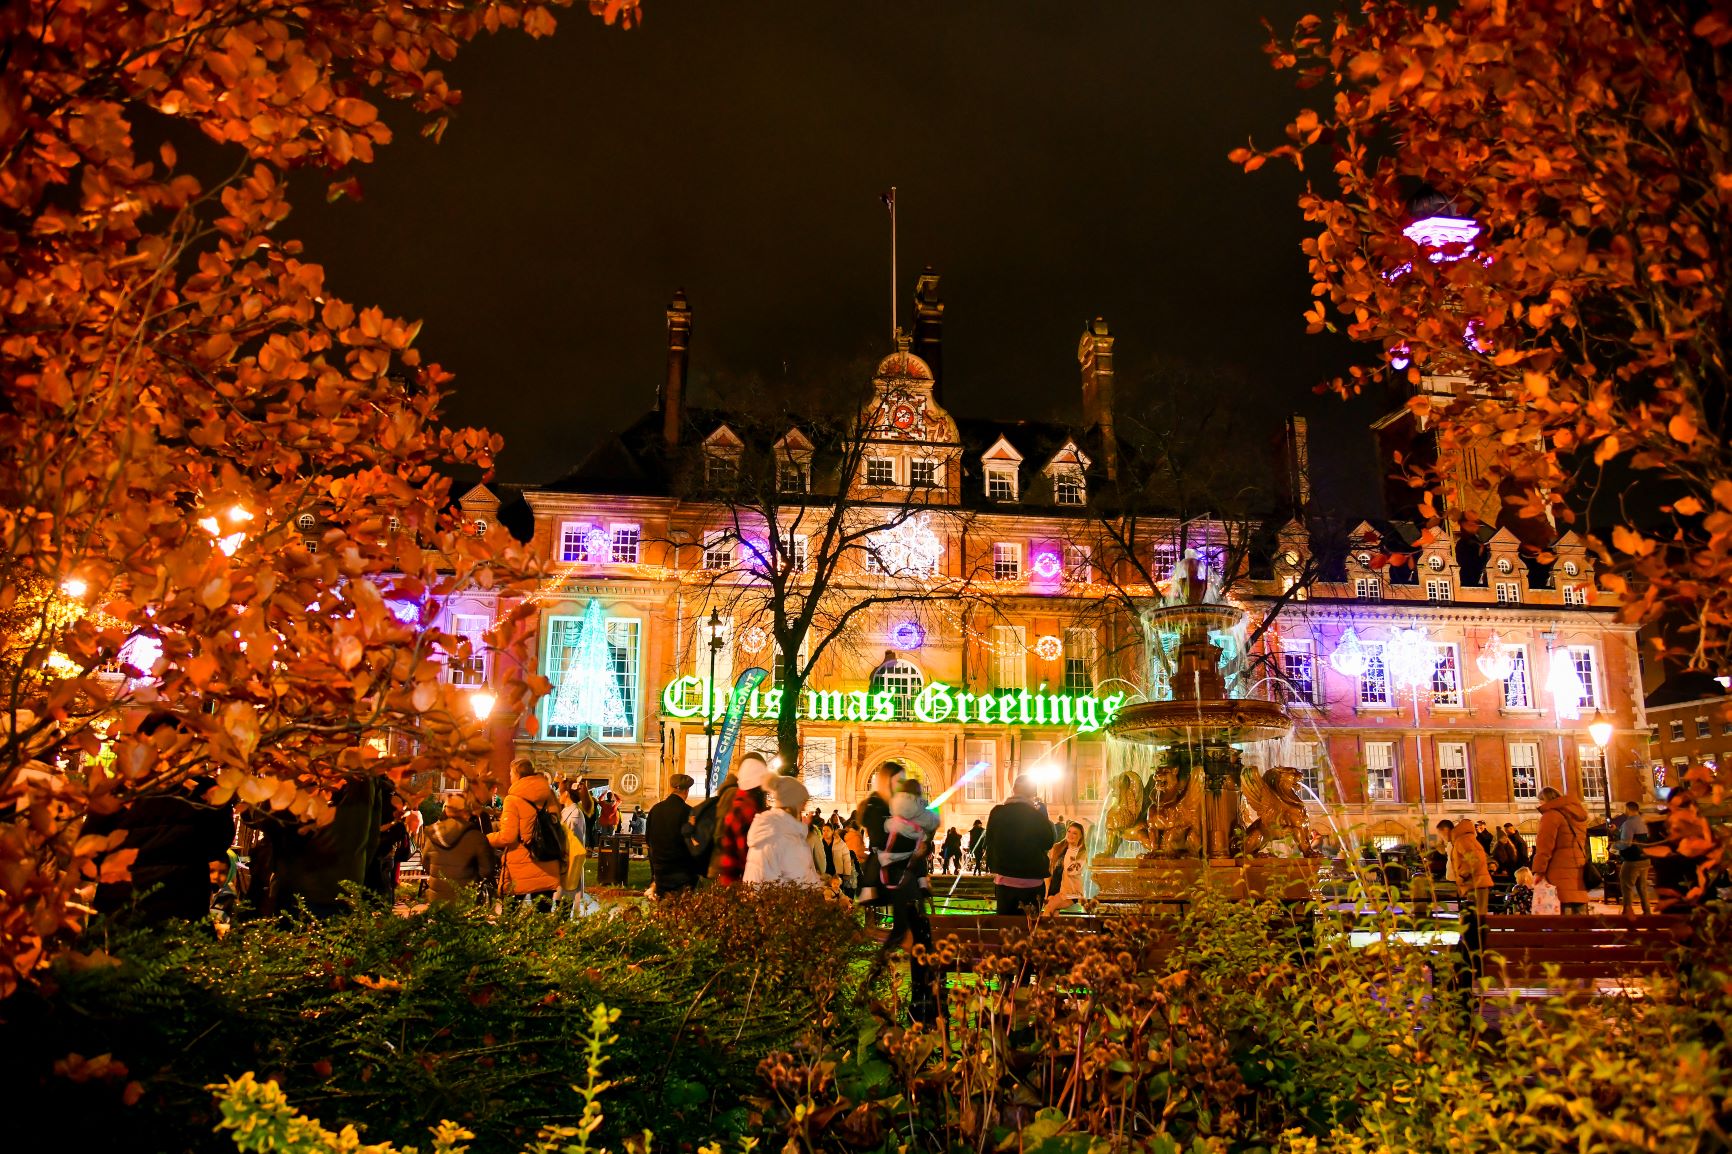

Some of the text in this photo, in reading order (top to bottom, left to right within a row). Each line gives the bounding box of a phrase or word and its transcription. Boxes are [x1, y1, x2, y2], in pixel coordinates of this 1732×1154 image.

[663, 675, 1124, 732] Chismas Greetings
[710, 673, 755, 789] LOST CHILD POINT
